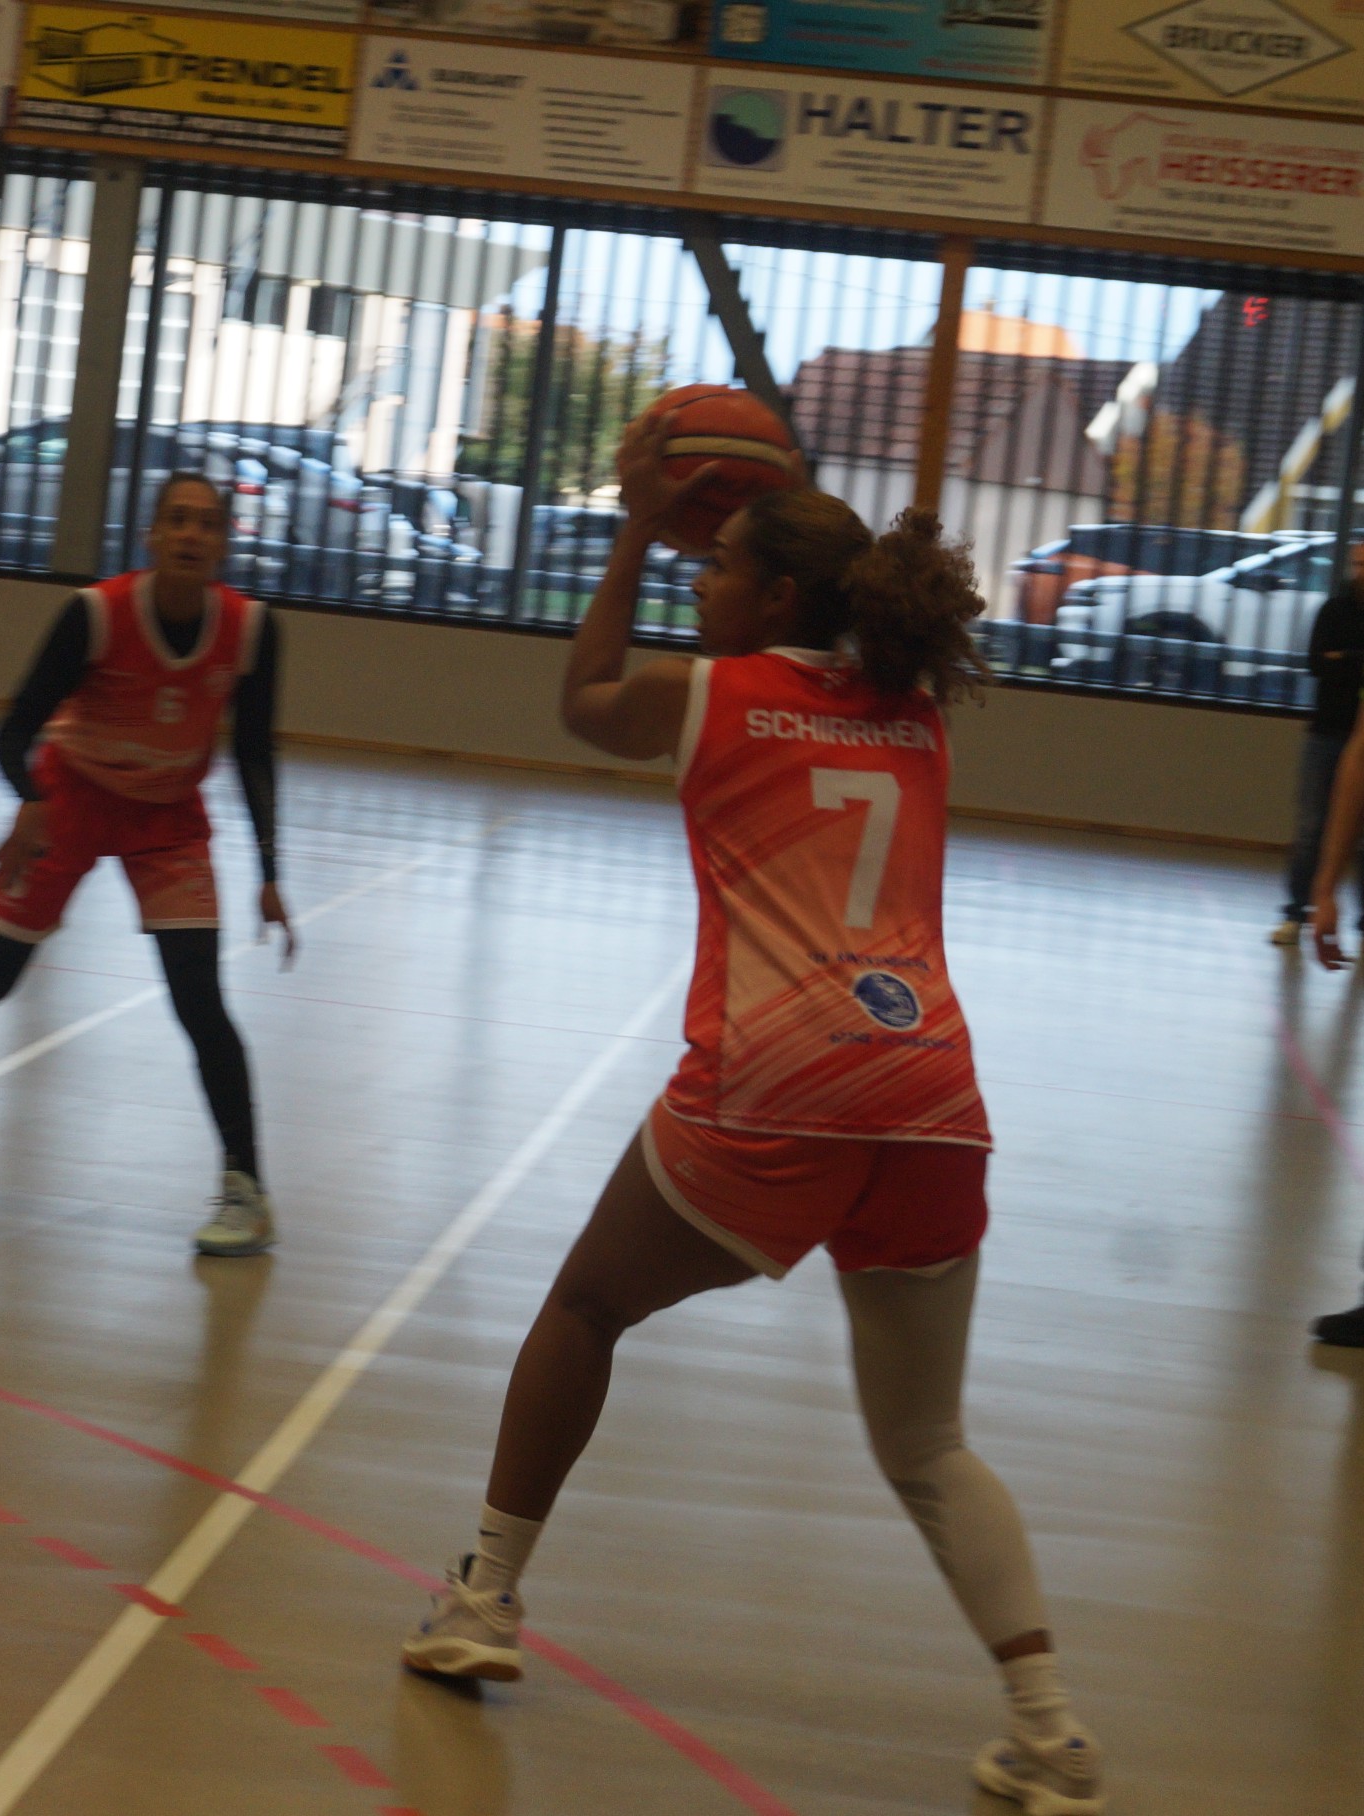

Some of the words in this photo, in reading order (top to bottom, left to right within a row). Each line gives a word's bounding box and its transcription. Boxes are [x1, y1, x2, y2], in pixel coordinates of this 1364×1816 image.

[1162, 23, 1310, 60] BRUCKER
[147, 51, 350, 95] TRENDEL
[797, 92, 1031, 155] HALTER
[1160, 152, 1361, 199] HEISSERER
[809, 766, 903, 931] 7
